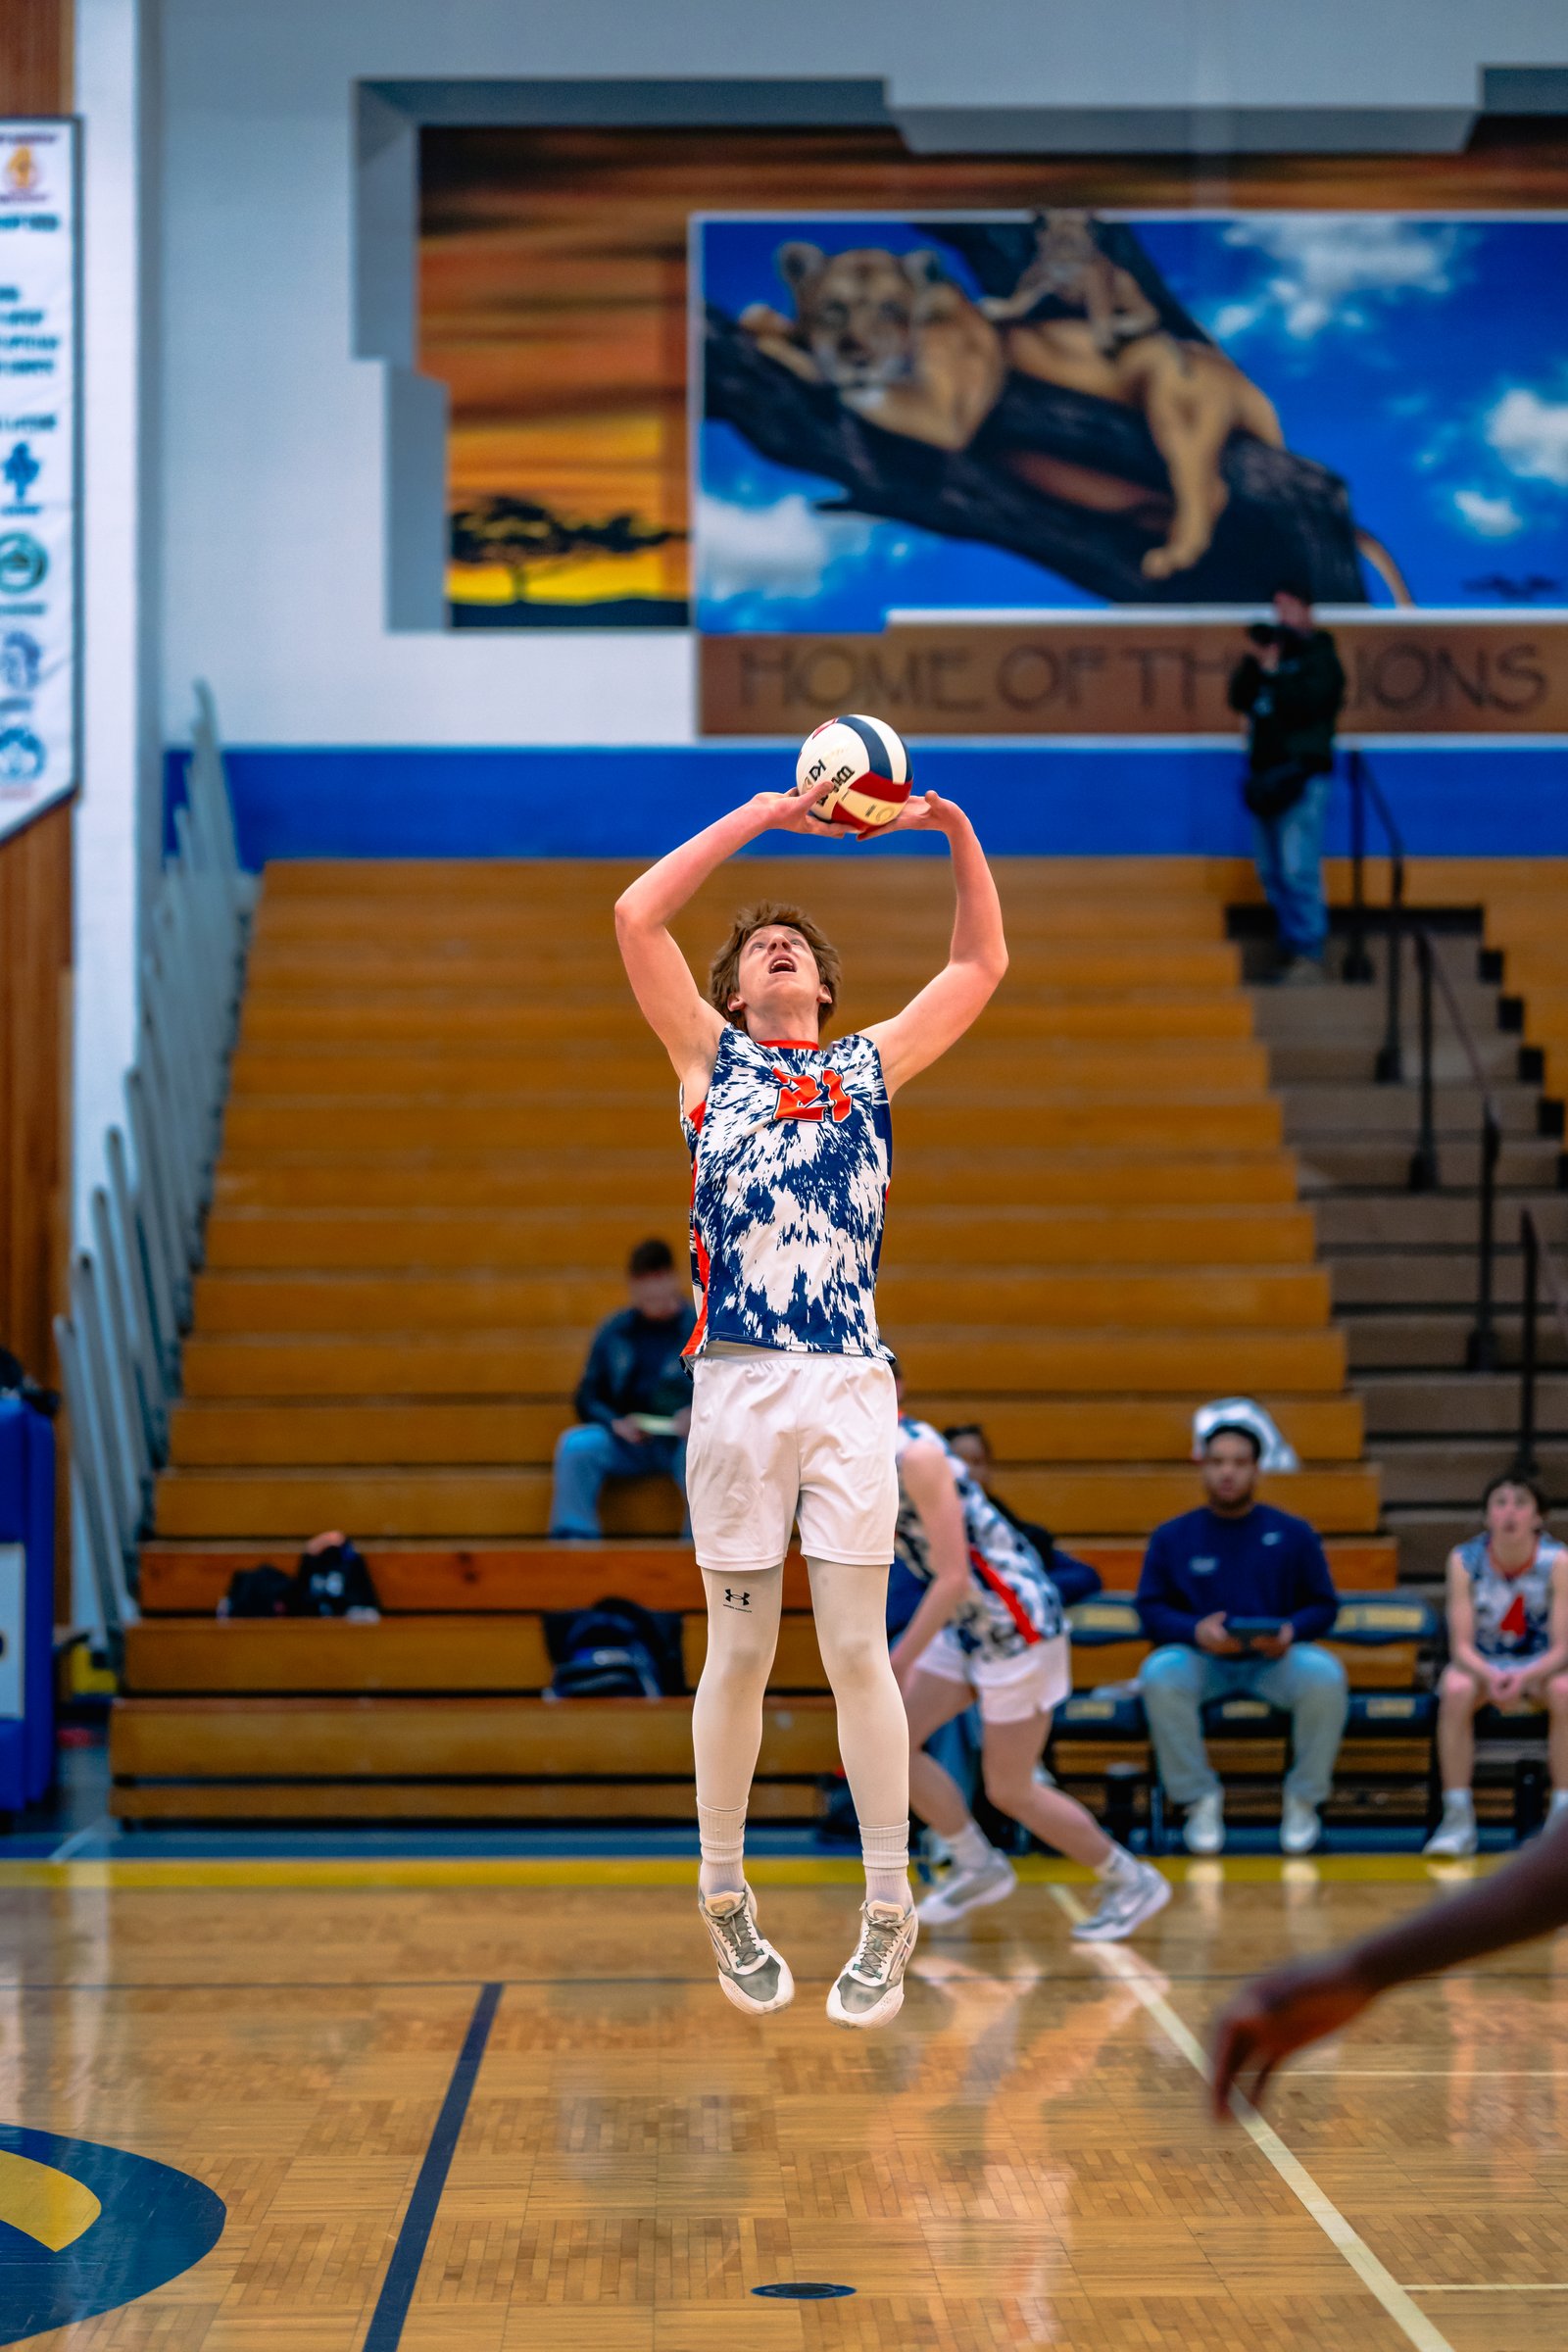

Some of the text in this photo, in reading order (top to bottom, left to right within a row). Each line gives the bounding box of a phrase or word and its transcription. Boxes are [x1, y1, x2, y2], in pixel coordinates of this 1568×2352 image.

[740, 641, 1547, 714] HOME OF TH IONS
[770, 1065, 854, 1124] 21
[1499, 1592, 1526, 1641] 4
